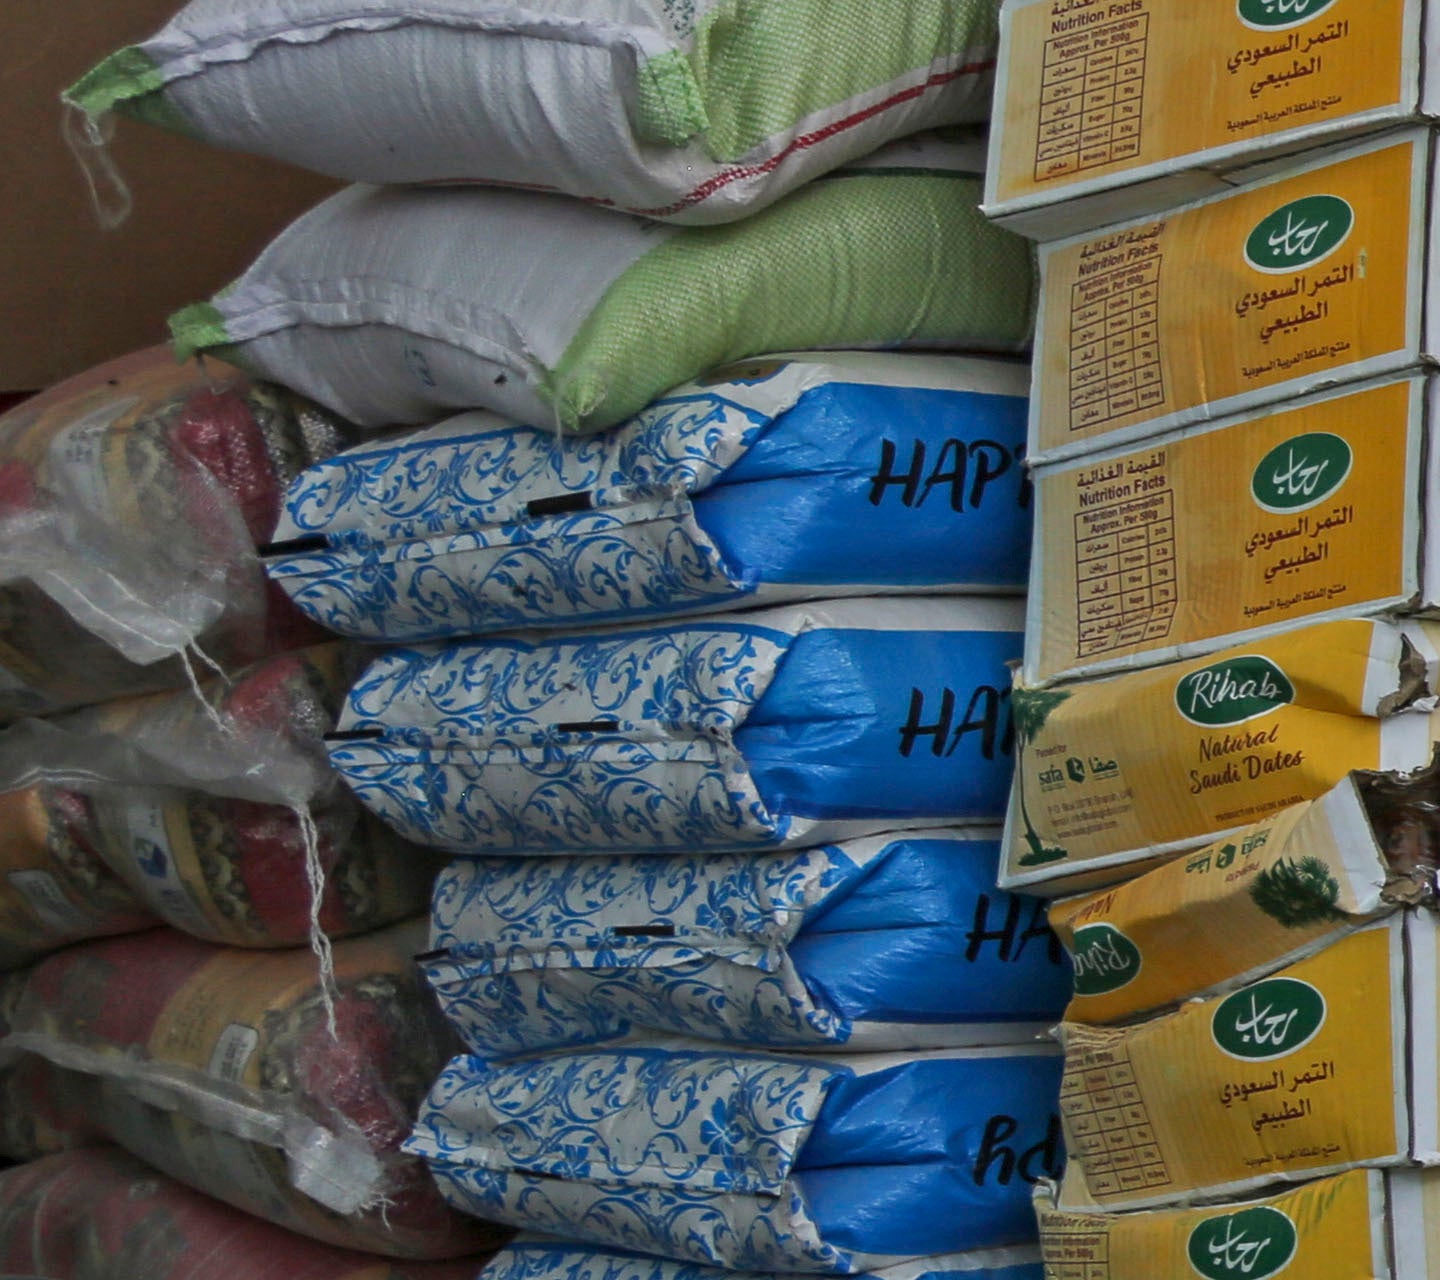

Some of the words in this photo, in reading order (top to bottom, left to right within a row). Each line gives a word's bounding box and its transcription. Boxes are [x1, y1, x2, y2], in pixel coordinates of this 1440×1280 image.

[1050, 8, 1106, 35] Nutrition
[1304, 19, 1350, 56] التمر
[1226, 33, 1301, 72] السعودي
[1248, 55, 1322, 99] الطبيعي
[1234, 276, 1305, 318] السعودي
[1310, 263, 1355, 297] التمر
[1258, 301, 1329, 344] الطبيعي
[1078, 483, 1132, 508] Nutrition
[1134, 475, 1166, 494] Facts
[1272, 448, 1328, 496] رحاب
[1244, 516, 1310, 558] السعودي
[1311, 504, 1354, 533] التمر
[1263, 542, 1329, 584] الطبيعي
[1188, 670, 1283, 715] Rihab
[1199, 724, 1279, 764] Natural
[1038, 764, 1066, 786] safa
[1189, 763, 1241, 795] Saudi
[1243, 749, 1306, 781] Dates
[1219, 1071, 1285, 1105] السعودي
[1292, 1062, 1335, 1089] التمر
[1251, 1100, 1312, 1132] الطبيعي
